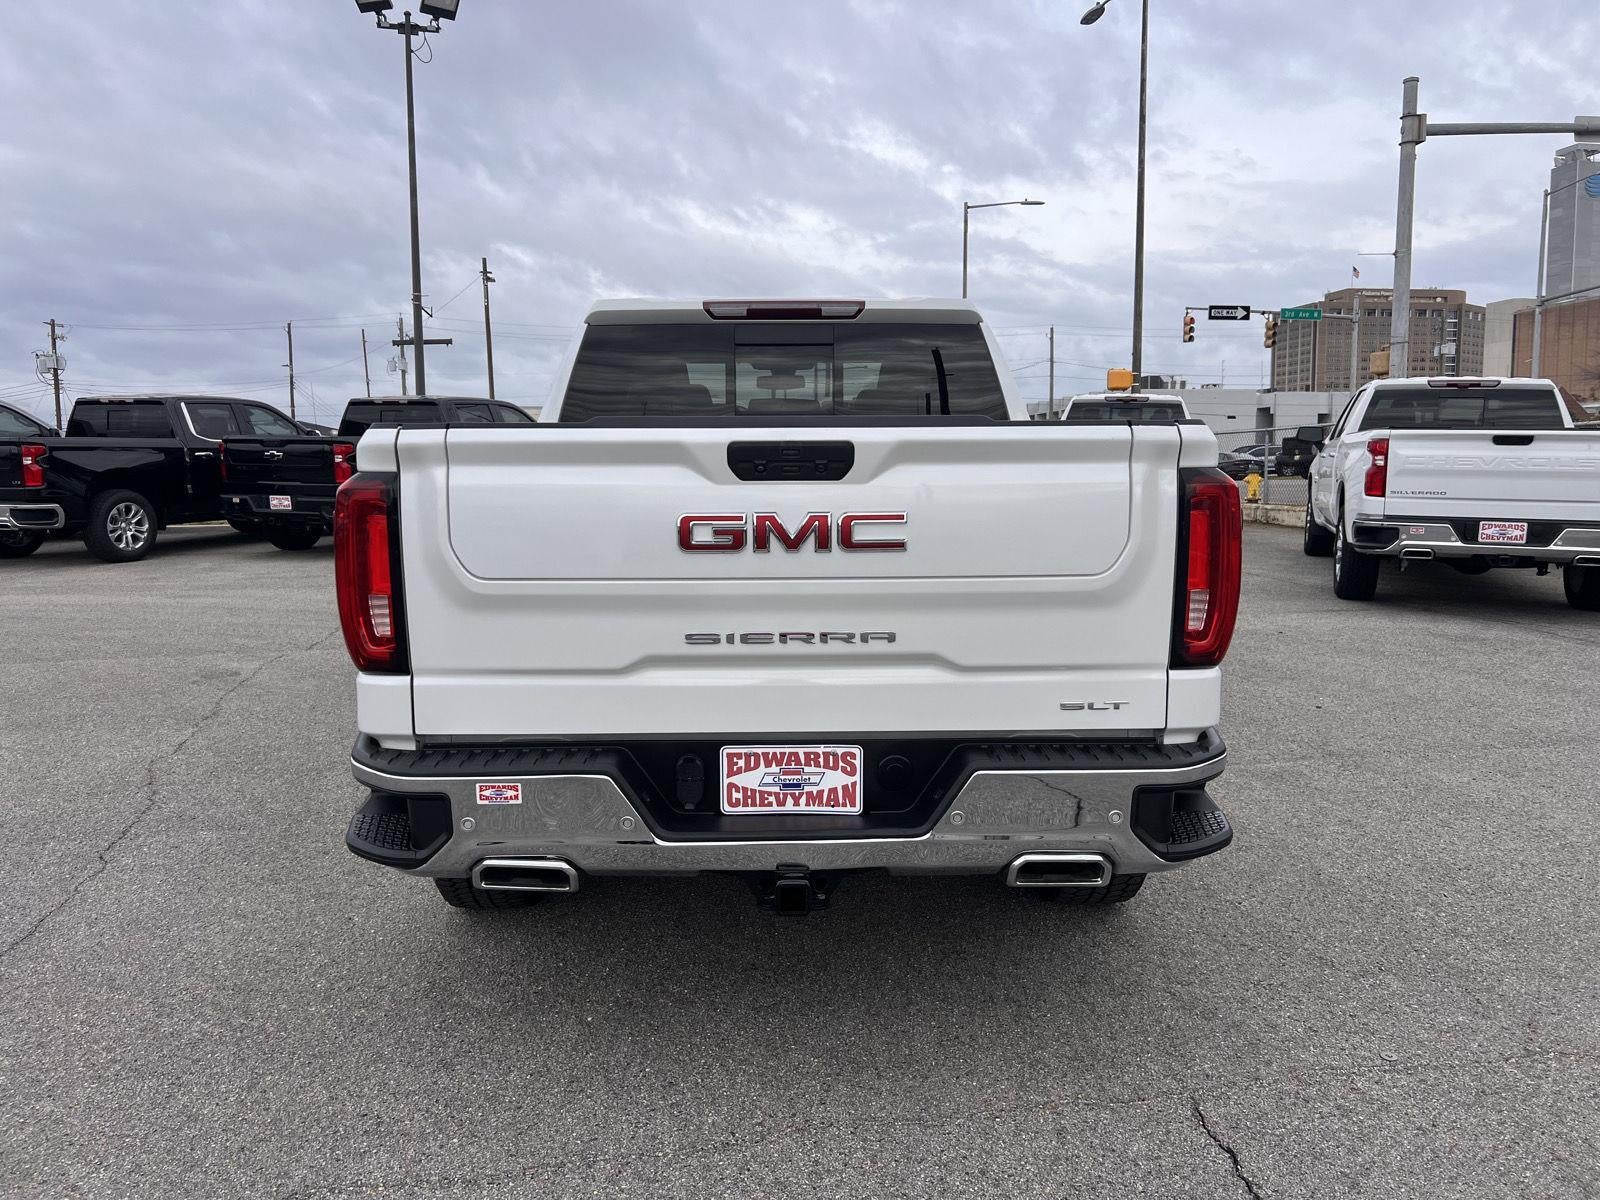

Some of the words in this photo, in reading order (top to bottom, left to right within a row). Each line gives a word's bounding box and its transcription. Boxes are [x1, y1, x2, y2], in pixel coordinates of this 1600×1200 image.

[677, 511, 908, 553] GMC
[1481, 523, 1525, 532] EDWARDS
[1480, 532, 1524, 541] CHEVYMAN
[684, 631, 897, 645] SIERRA
[1060, 700, 1130, 710] SLT
[726, 751, 858, 778] EDWARDS
[726, 781, 857, 808] CHEVYMAN
